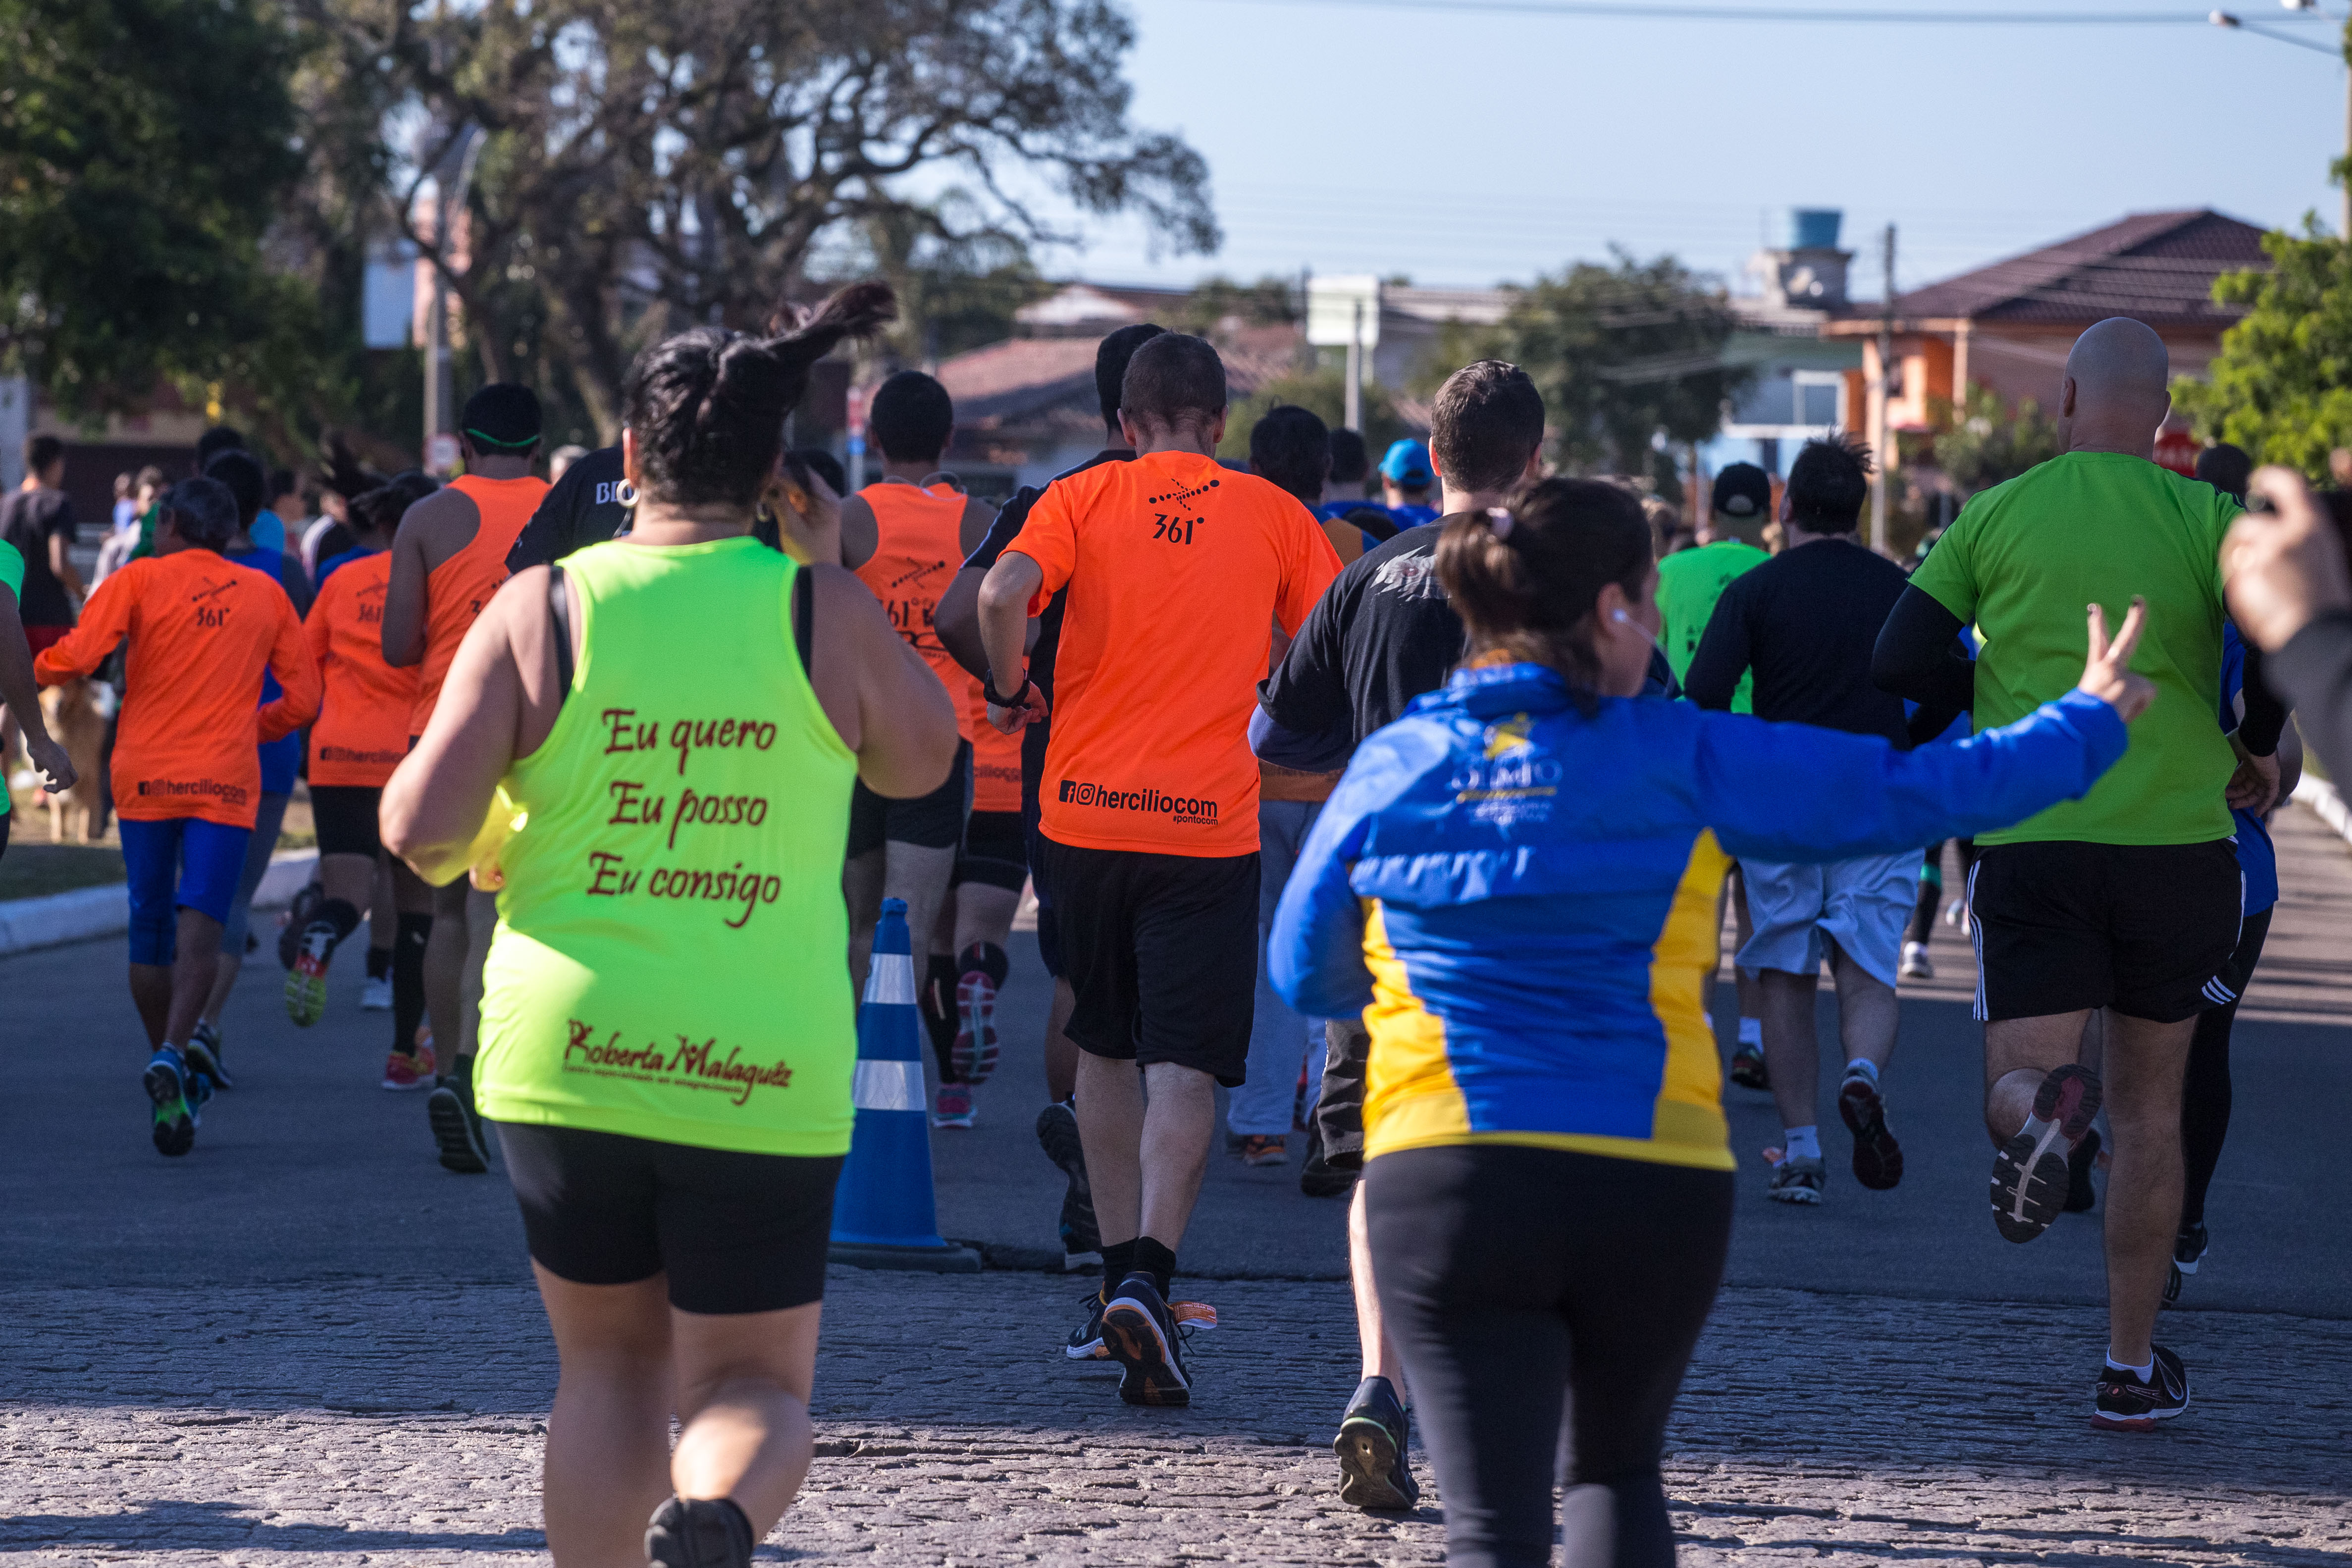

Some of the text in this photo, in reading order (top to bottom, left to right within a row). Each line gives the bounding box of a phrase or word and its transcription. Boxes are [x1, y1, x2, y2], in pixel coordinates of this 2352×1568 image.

[601, 708, 777, 776] Eu quero
[609, 781, 768, 850] Eu posso
[1095, 784, 1218, 818] herciliocom
[1173, 815, 1218, 826] #pontocom
[586, 851, 781, 928] Eu consigo
[564, 1019, 665, 1071] Roberta
